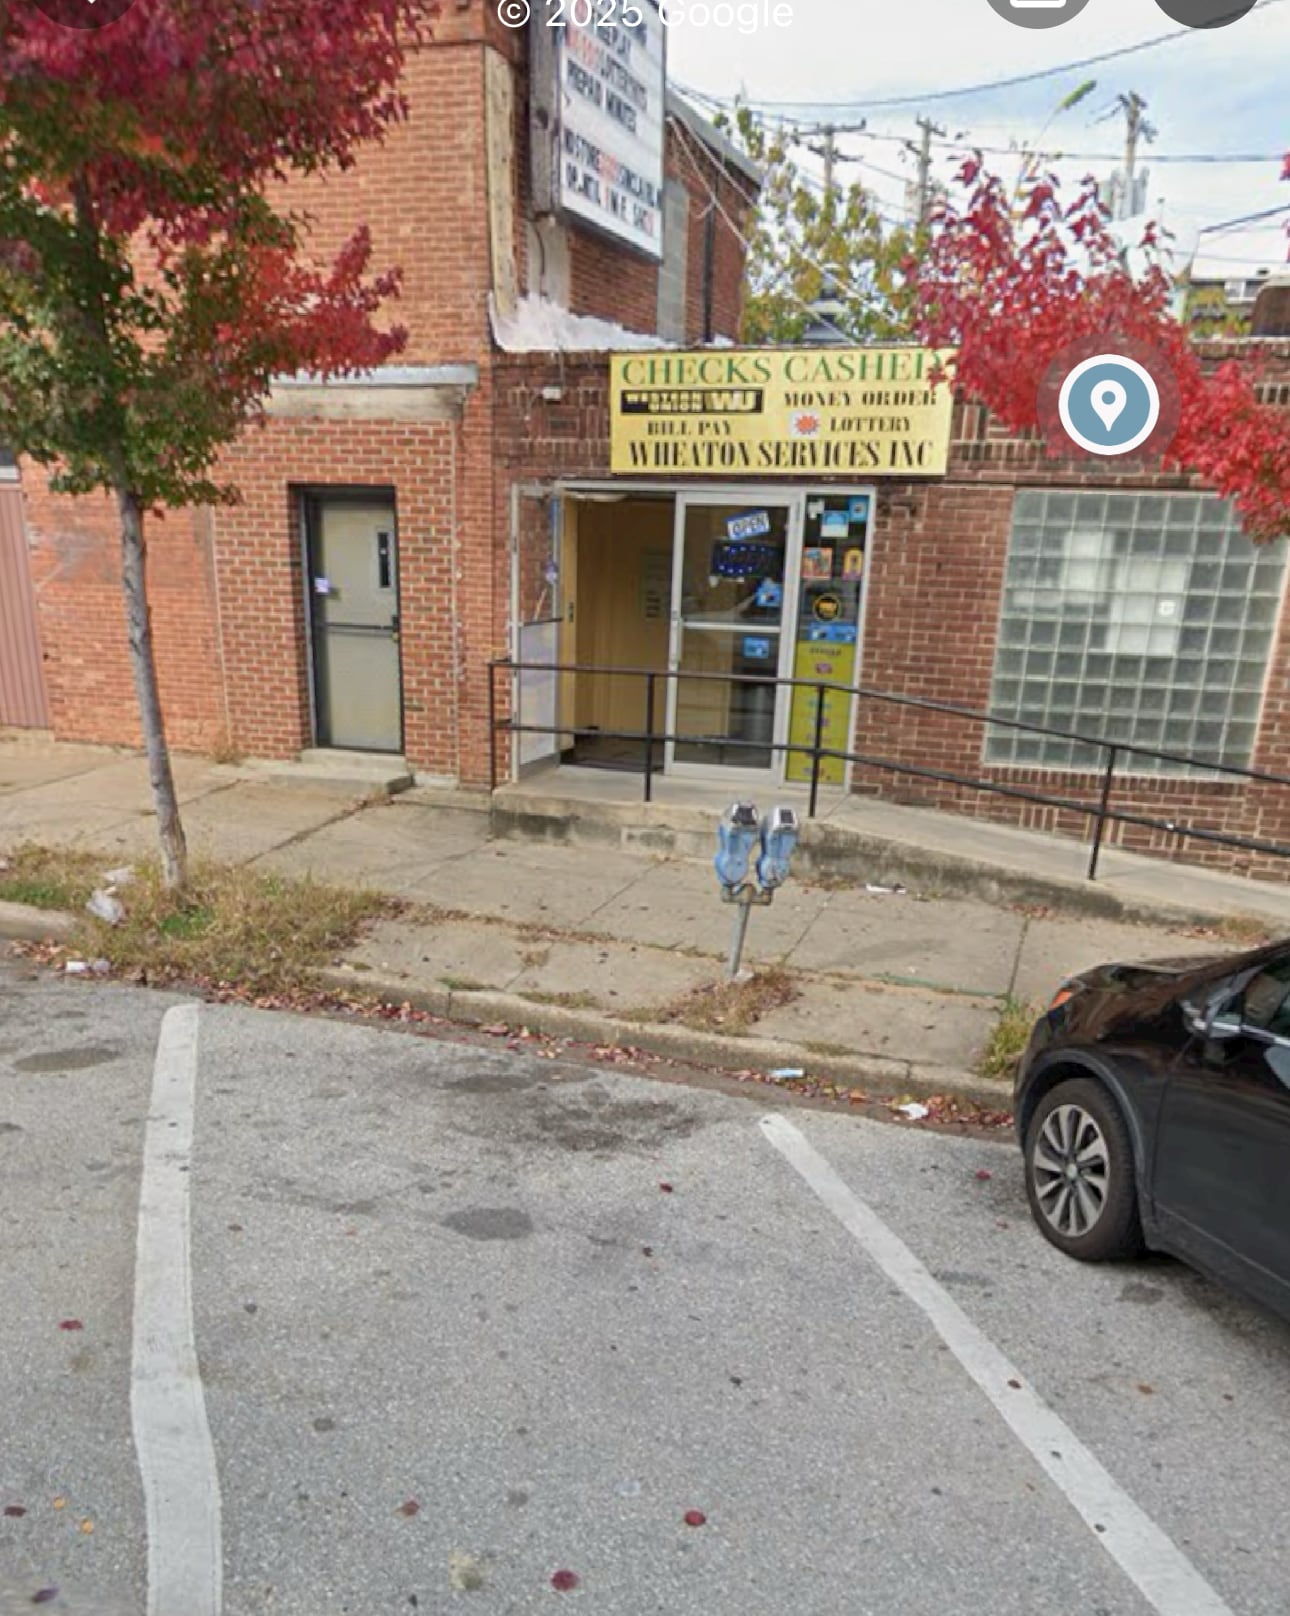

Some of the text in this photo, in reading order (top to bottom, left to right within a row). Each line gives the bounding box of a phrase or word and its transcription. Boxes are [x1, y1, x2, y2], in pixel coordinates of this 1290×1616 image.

[621, 355, 772, 386] CHECKS
[784, 390, 937, 407] MONEY ORDER
[647, 422, 733, 436] BILL PAY
[830, 417, 911, 433] LOTTERY
[629, 440, 934, 467] WHEATON SERVICES INC
